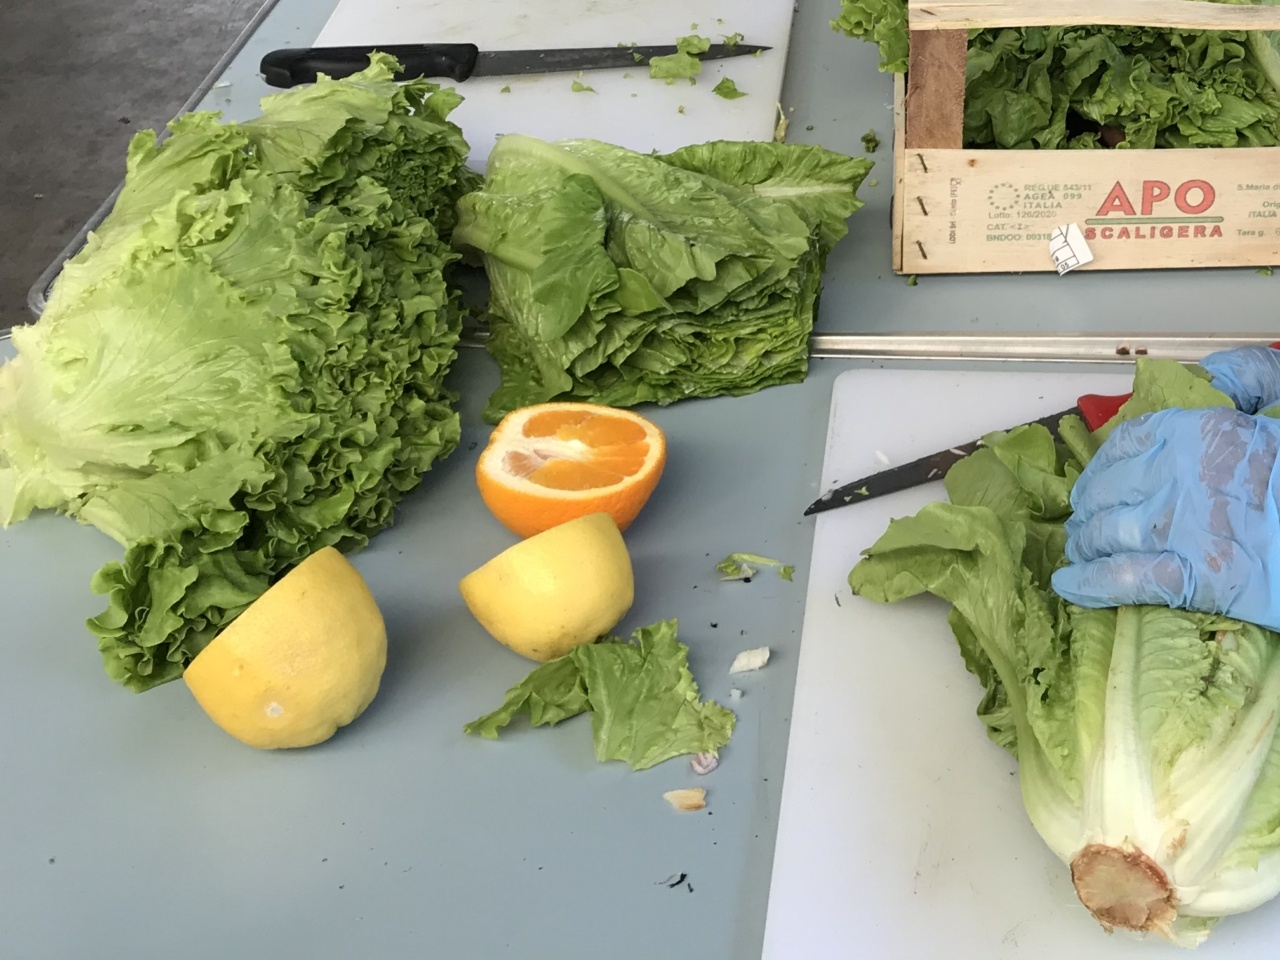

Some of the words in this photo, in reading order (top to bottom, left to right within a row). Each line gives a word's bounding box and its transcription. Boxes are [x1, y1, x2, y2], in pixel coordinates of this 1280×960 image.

[1023, 192, 1055, 201] AGEA
[1063, 192, 1082, 201] 099
[1095, 179, 1216, 216] APO
[1023, 201, 1063, 209] ITALIA
[1084, 225, 1222, 241] SCALIGERA
